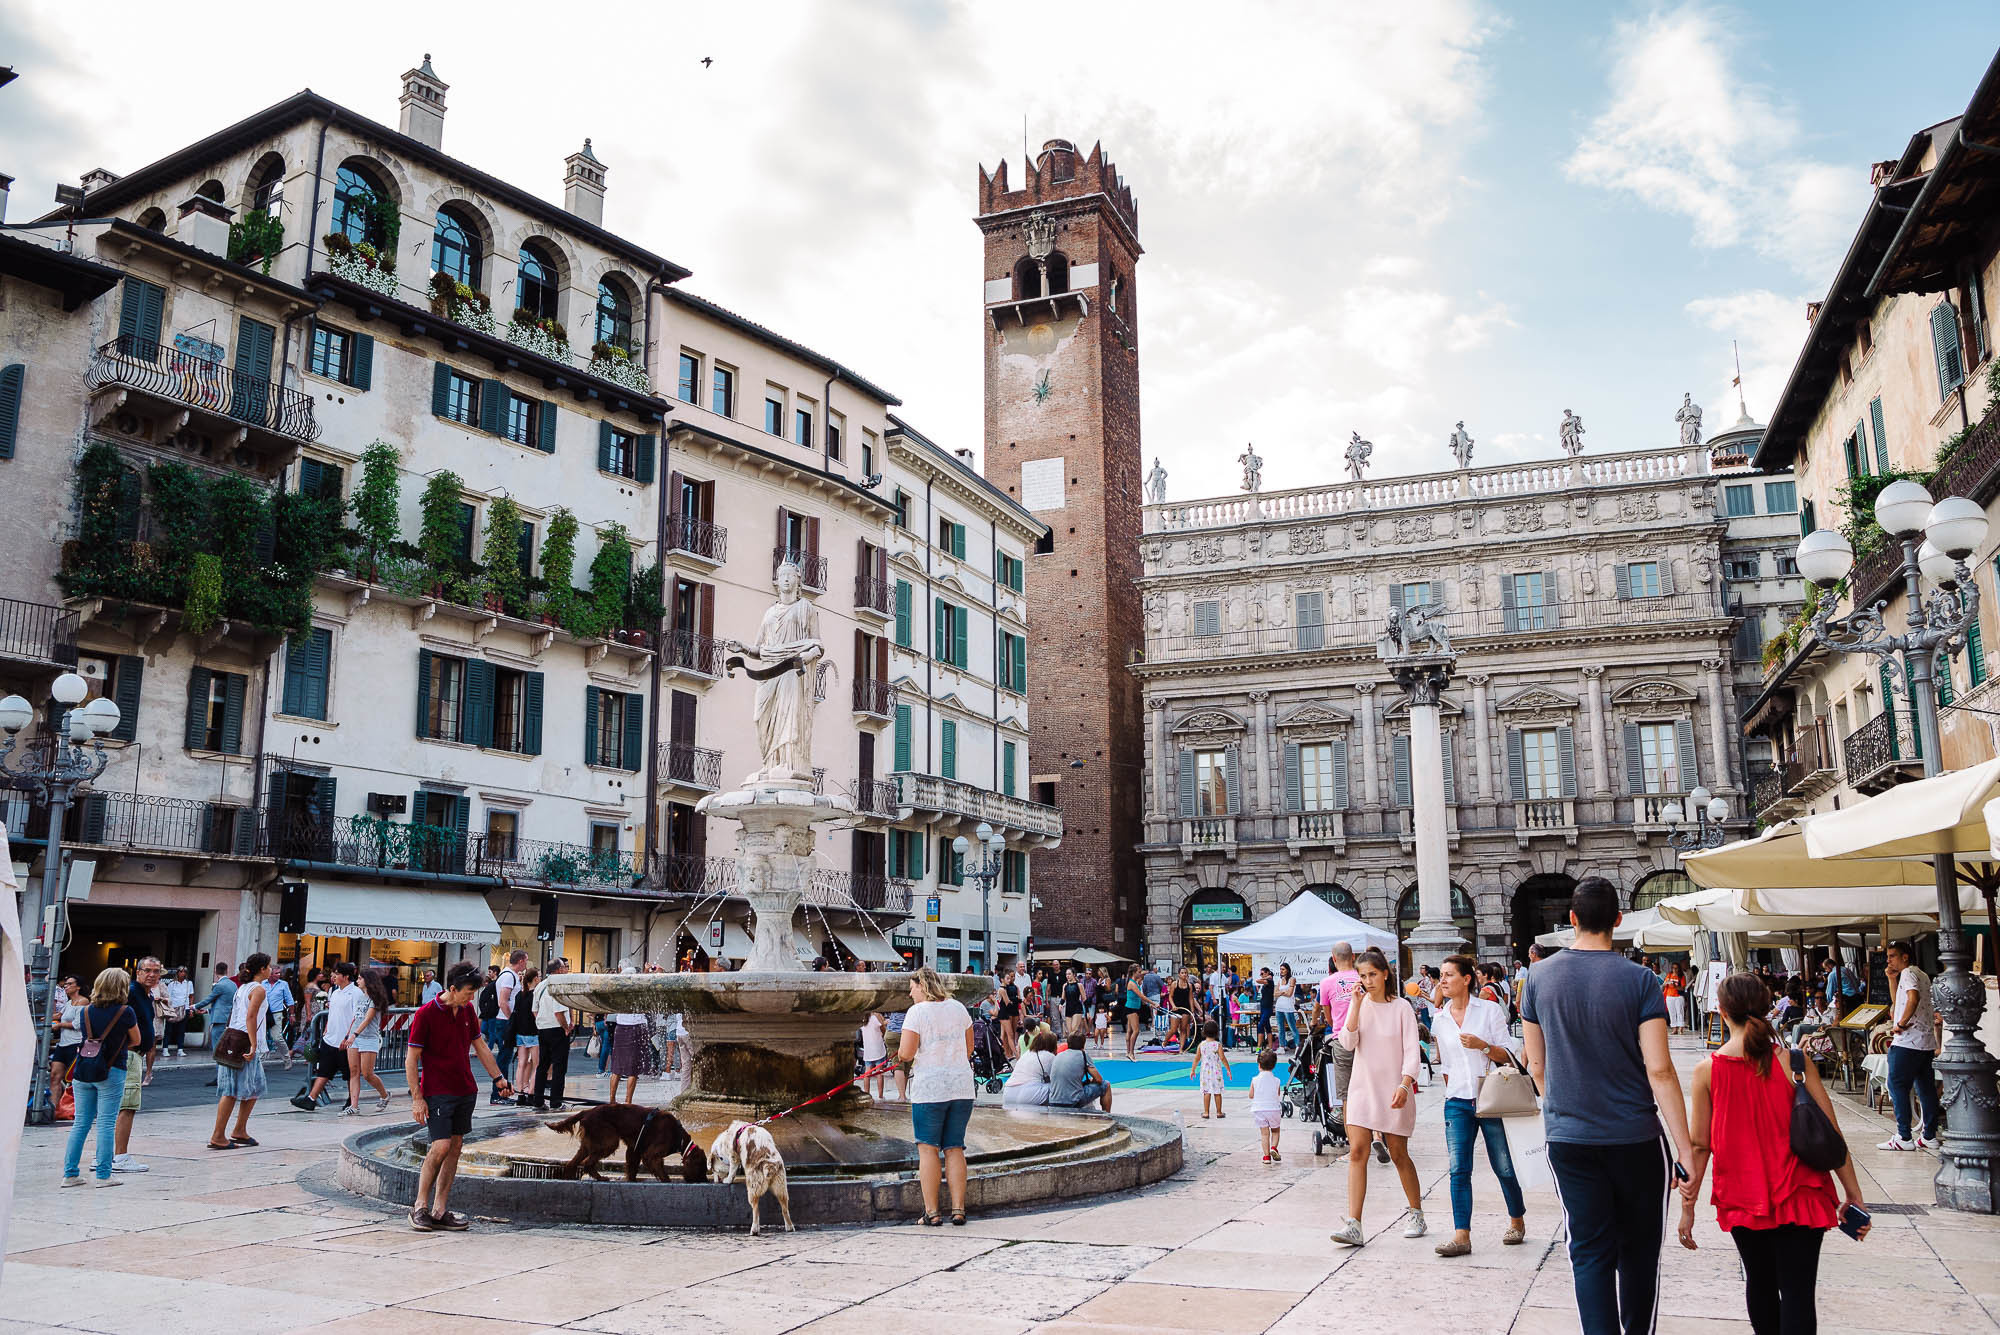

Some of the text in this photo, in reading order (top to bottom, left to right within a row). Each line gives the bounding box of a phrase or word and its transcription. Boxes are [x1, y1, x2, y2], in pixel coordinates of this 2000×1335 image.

[325, 925, 479, 941] GALLERIA D'ARTE "PIAZZA ERBE"
[895, 936, 922, 948] TABACCHI
